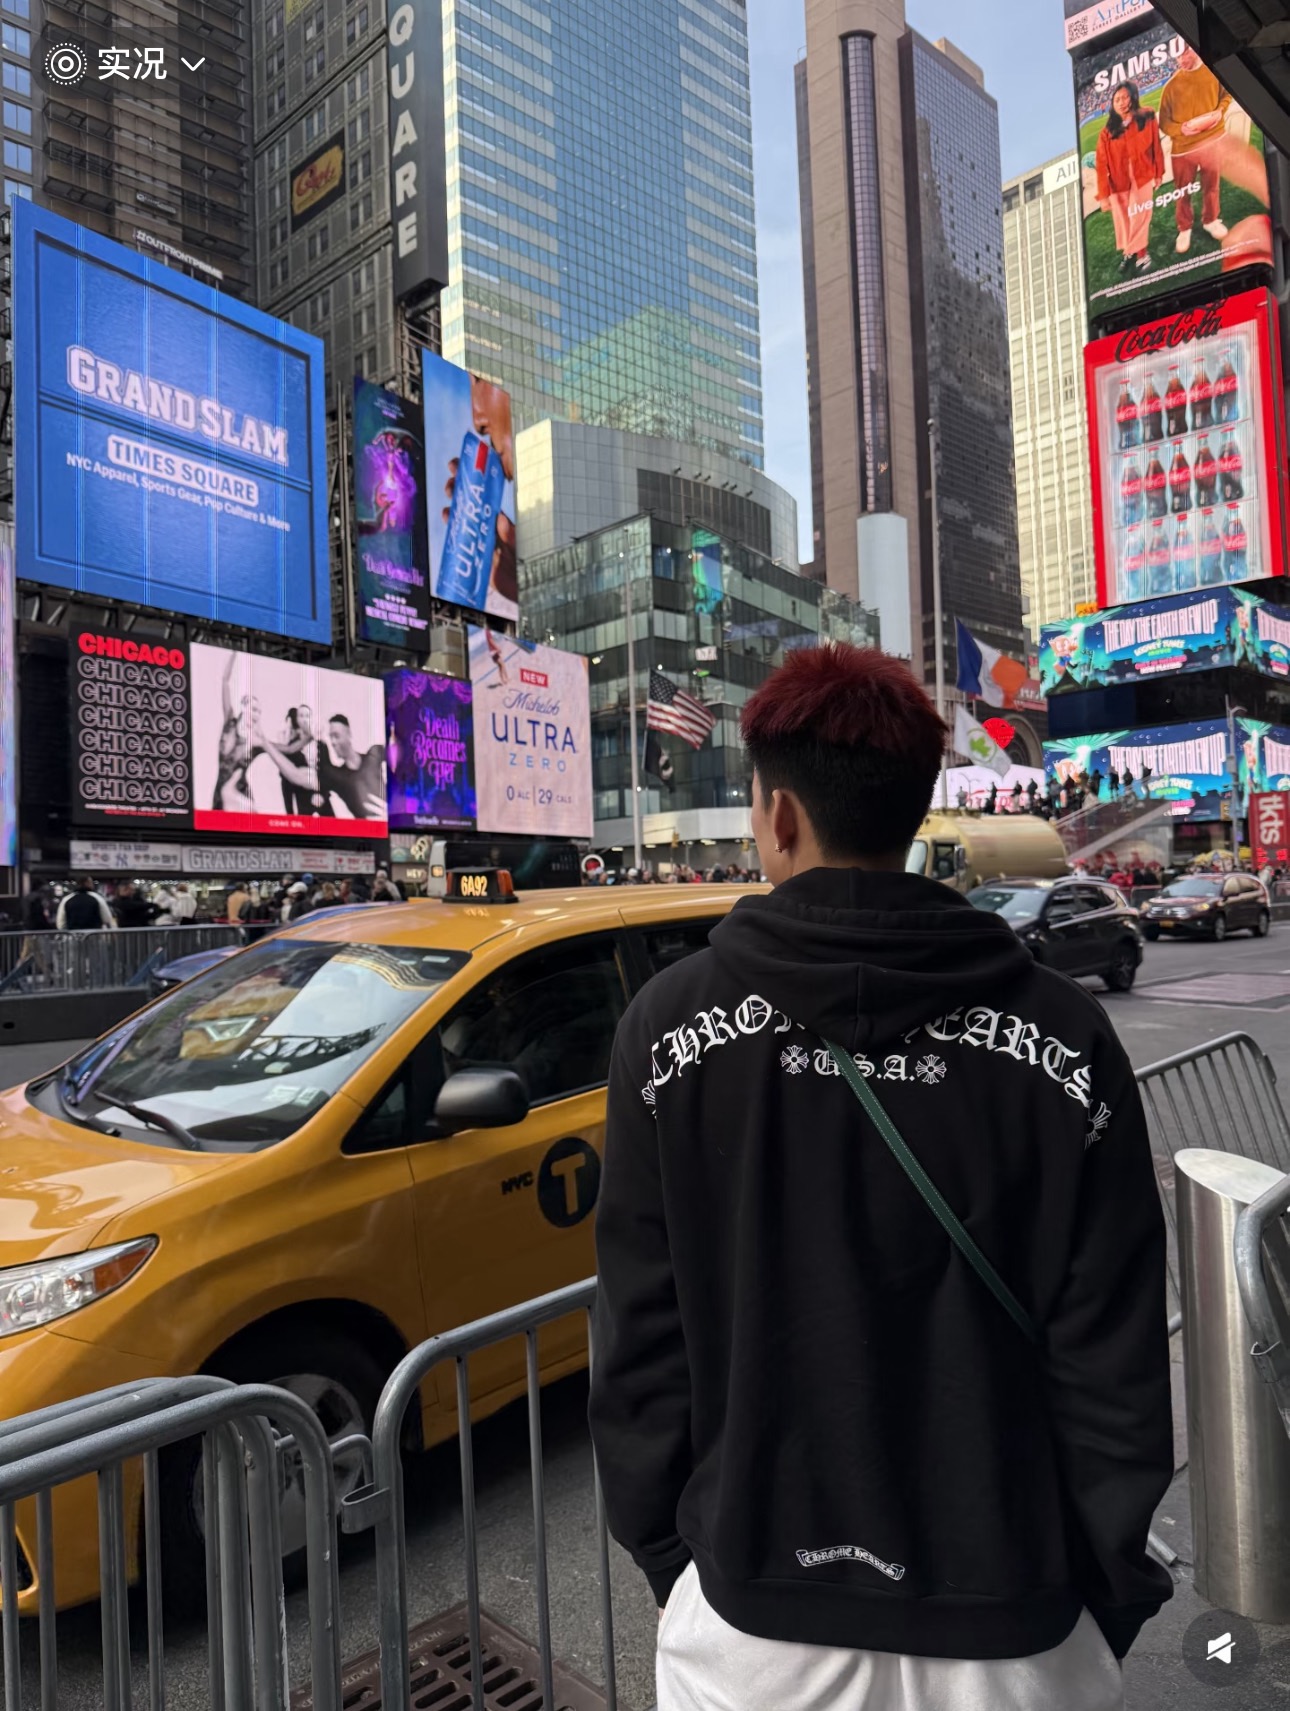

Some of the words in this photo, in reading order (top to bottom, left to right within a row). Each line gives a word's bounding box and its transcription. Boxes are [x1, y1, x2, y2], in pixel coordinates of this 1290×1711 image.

[1128, 199, 1153, 217] Live
[1155, 181, 1201, 208] sports
[66, 344, 200, 434] GRAND
[199, 398, 289, 467] SLAM
[66, 451, 91, 471] NYC
[93, 460, 140, 488] Apparel,
[141, 477, 176, 498] Sports
[204, 494, 223, 513] Pop
[225, 500, 259, 523] Culture
[113, 441, 175, 478] TIMES
[181, 463, 256, 501] SQUARE
[455, 483, 486, 579] ULTRA
[475, 504, 492, 569] ZERO
[78, 632, 186, 669] CHICAGO
[77, 655, 187, 693] CHICAGO
[522, 671, 547, 684] NEW
[77, 679, 188, 716] CHICAGO
[502, 688, 560, 716] Michelob
[78, 703, 188, 738] CHICAGO
[419, 706, 460, 741] Death
[492, 712, 578, 754] ULTRA
[78, 727, 189, 761] CHICAGO
[411, 730, 467, 768] Becomes
[78, 751, 189, 783] CHICAGO
[428, 760, 456, 791] Her
[509, 752, 566, 773] ZERO
[78, 776, 189, 806] CHICAGO
[506, 785, 515, 801] 0
[517, 790, 530, 801] ALC
[538, 788, 553, 805] 29
[1259, 794, 1285, 845] tkts
[190, 849, 250, 870] GRAND
[250, 850, 293, 871] SLAM
[460, 875, 488, 897] 6A92
[813, 1048, 916, 1082] US.A.
[903, 1006, 1092, 1108] EARTS
[502, 1171, 534, 1196] NYC
[551, 1151, 586, 1216] T
